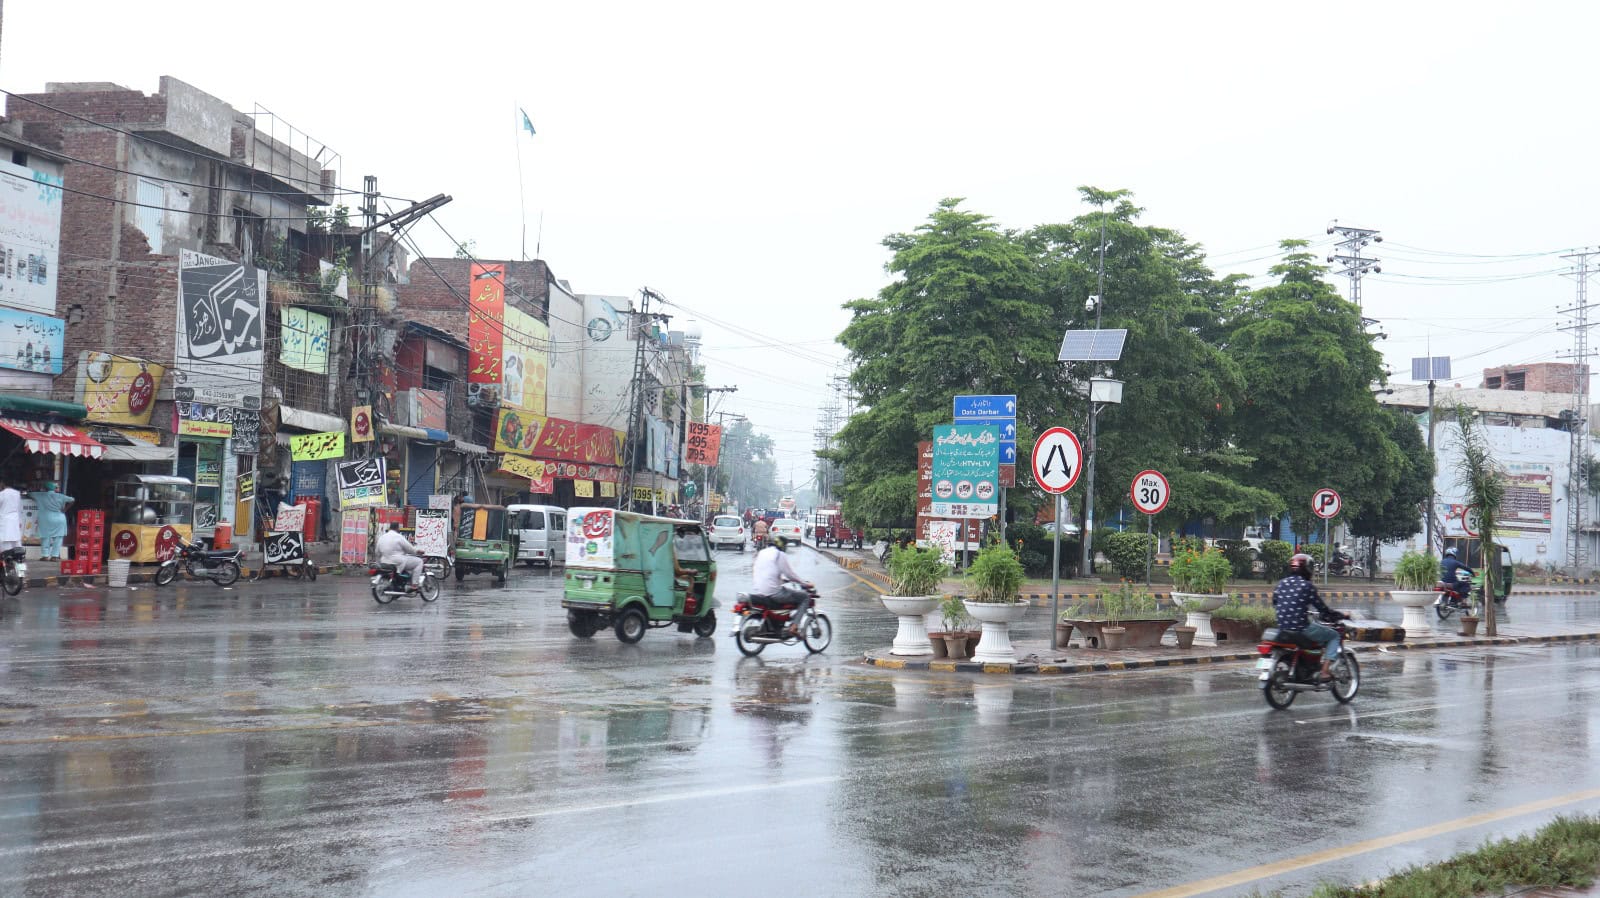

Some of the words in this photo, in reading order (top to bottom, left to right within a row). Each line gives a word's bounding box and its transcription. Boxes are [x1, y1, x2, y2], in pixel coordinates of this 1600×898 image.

[194, 254, 215, 266] JANG
[189, 266, 259, 357] جنگ
[689, 422, 709, 436] 1295
[689, 435, 707, 448] 495
[688, 447, 705, 461] 795
[633, 488, 652, 500] 1395
[1140, 488, 1160, 504] 30
[1321, 494, 1334, 512] P
[267, 532, 300, 563] جنگ
